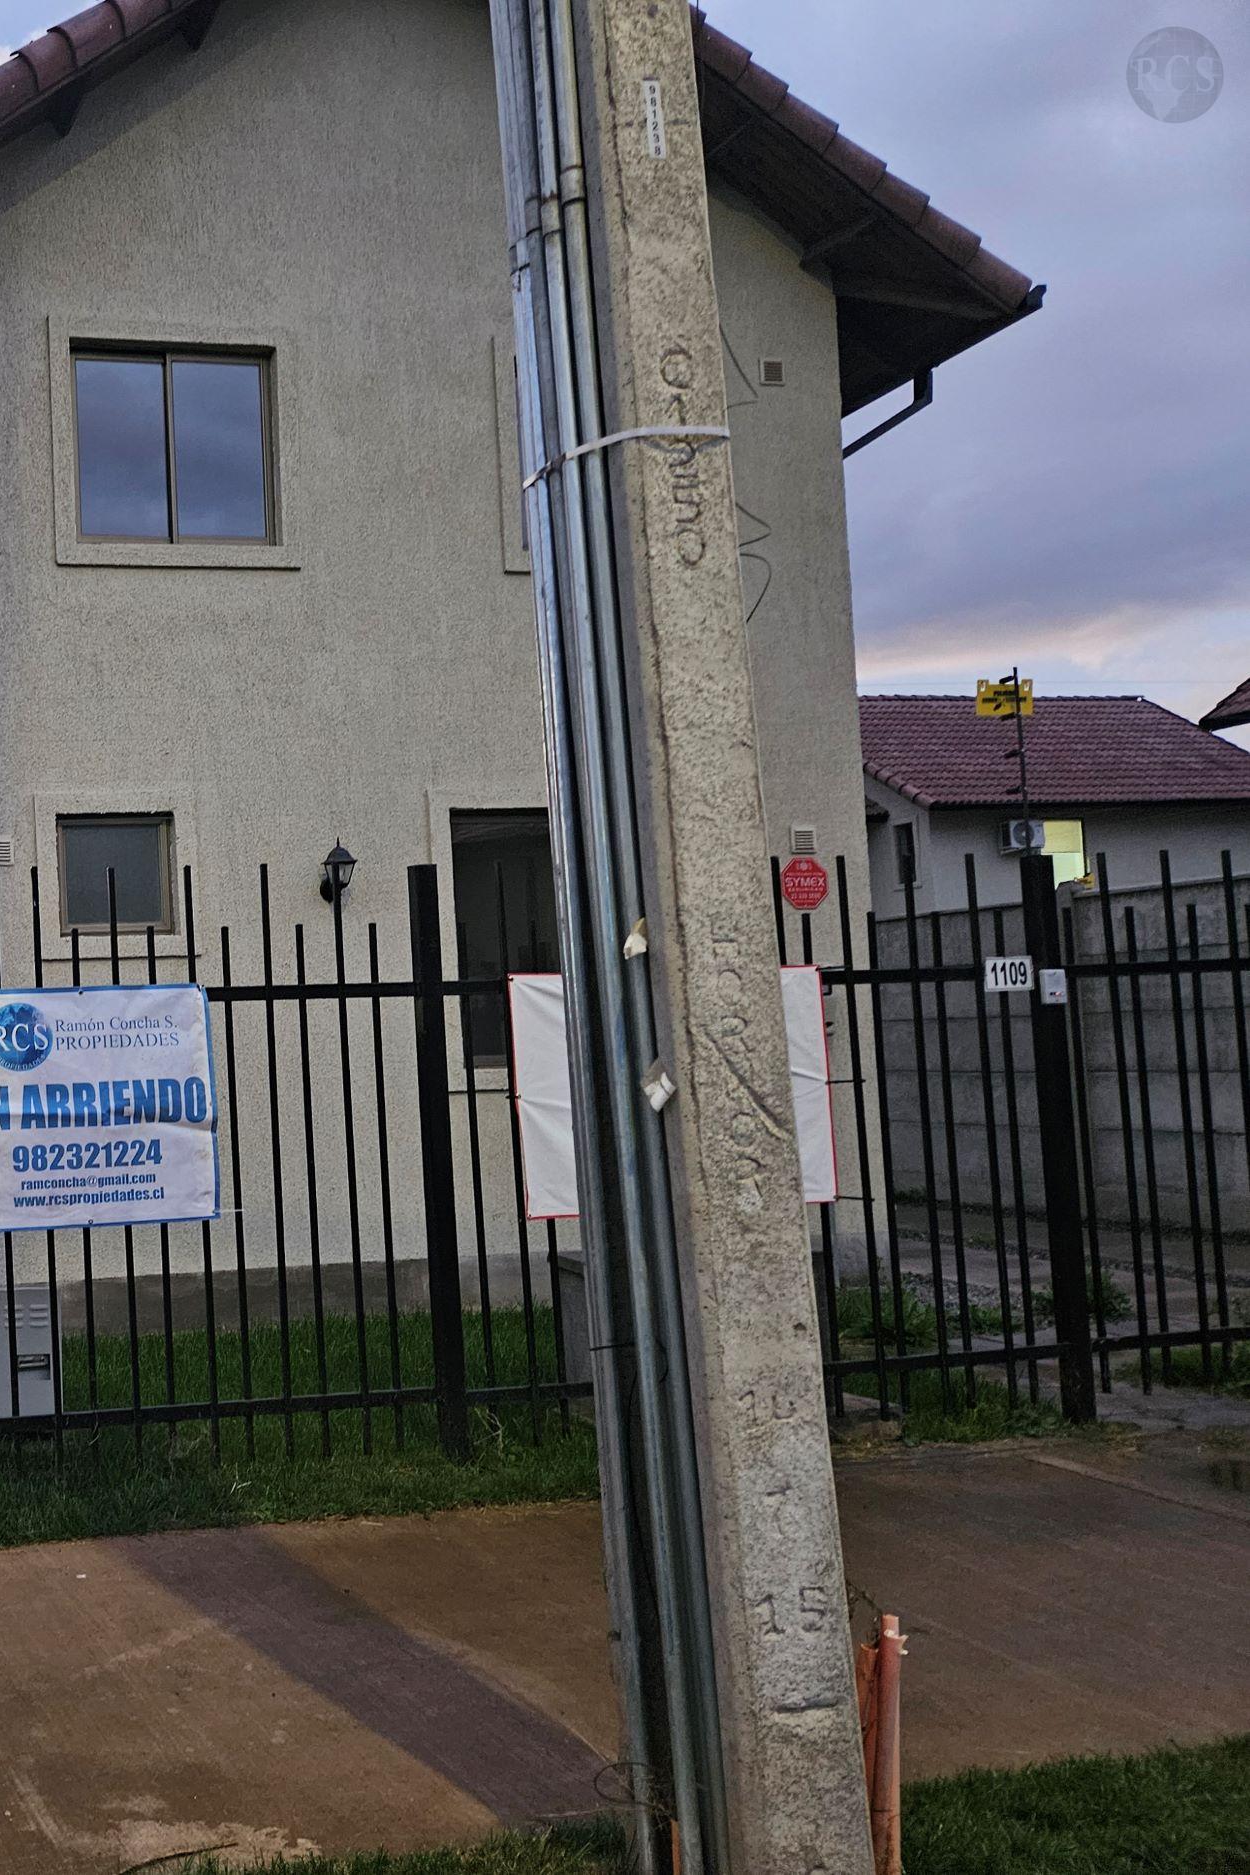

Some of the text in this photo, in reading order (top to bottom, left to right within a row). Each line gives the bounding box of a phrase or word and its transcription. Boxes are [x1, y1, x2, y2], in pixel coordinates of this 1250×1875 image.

[785, 876, 825, 887] SYMEX
[991, 961, 1028, 986] 1109
[55, 1015, 178, 1032] Ramón Concha S.
[55, 1032, 180, 1050] PROPIEDADES
[20, 1076, 207, 1130] ARRIENDO
[12, 1139, 163, 1173] 982321224
[20, 1173, 157, 1191] ramconcha@gmail.com
[13, 1187, 165, 1208] www.rcspropiedades.cl
